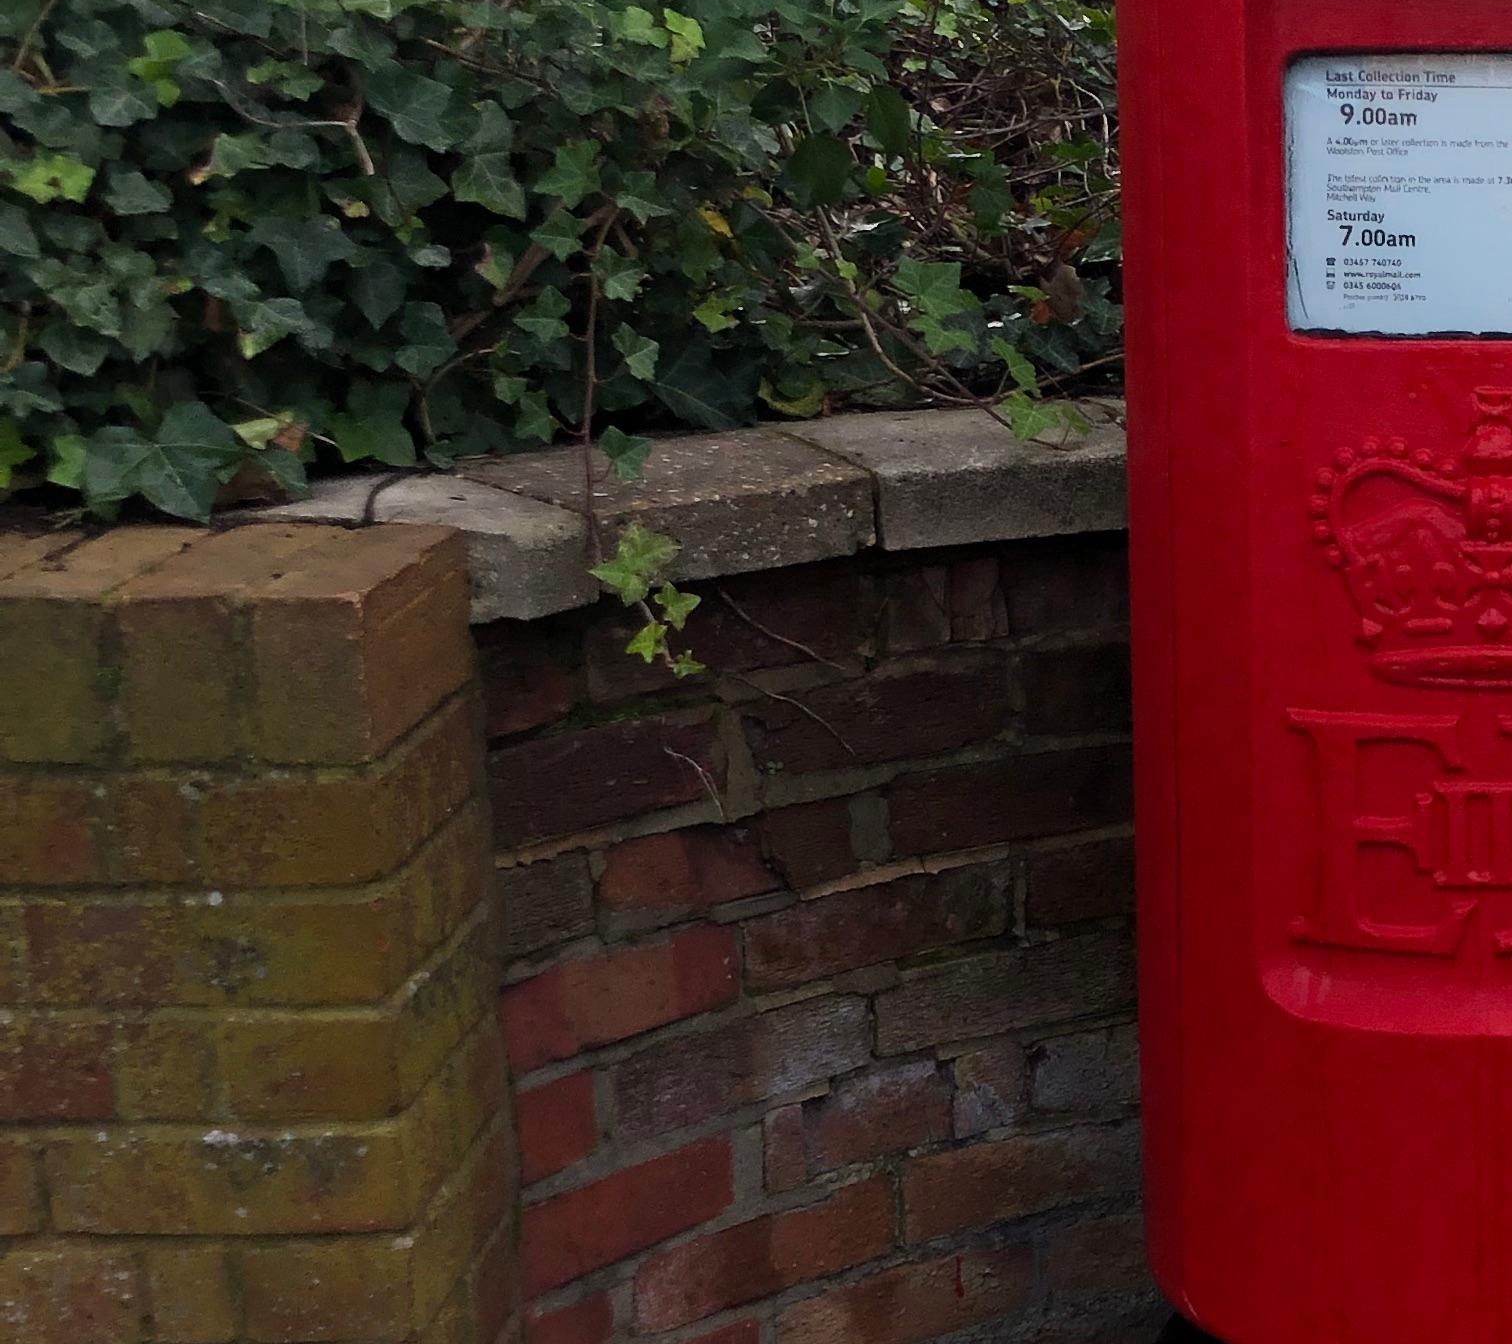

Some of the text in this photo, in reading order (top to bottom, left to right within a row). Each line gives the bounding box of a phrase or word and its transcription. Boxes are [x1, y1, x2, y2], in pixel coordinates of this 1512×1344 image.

[1325, 70, 1457, 84] Last Collection Time
[1326, 88, 1439, 103] Monday to Friday
[1340, 103, 1418, 126] 9.00am
[1327, 209, 1385, 224] Saturday
[1339, 224, 1416, 247] 7.00am
[1343, 258, 1369, 266] 03457
[1343, 269, 1421, 279] www.royalmail.com
[1343, 281, 1364, 290] 0345
